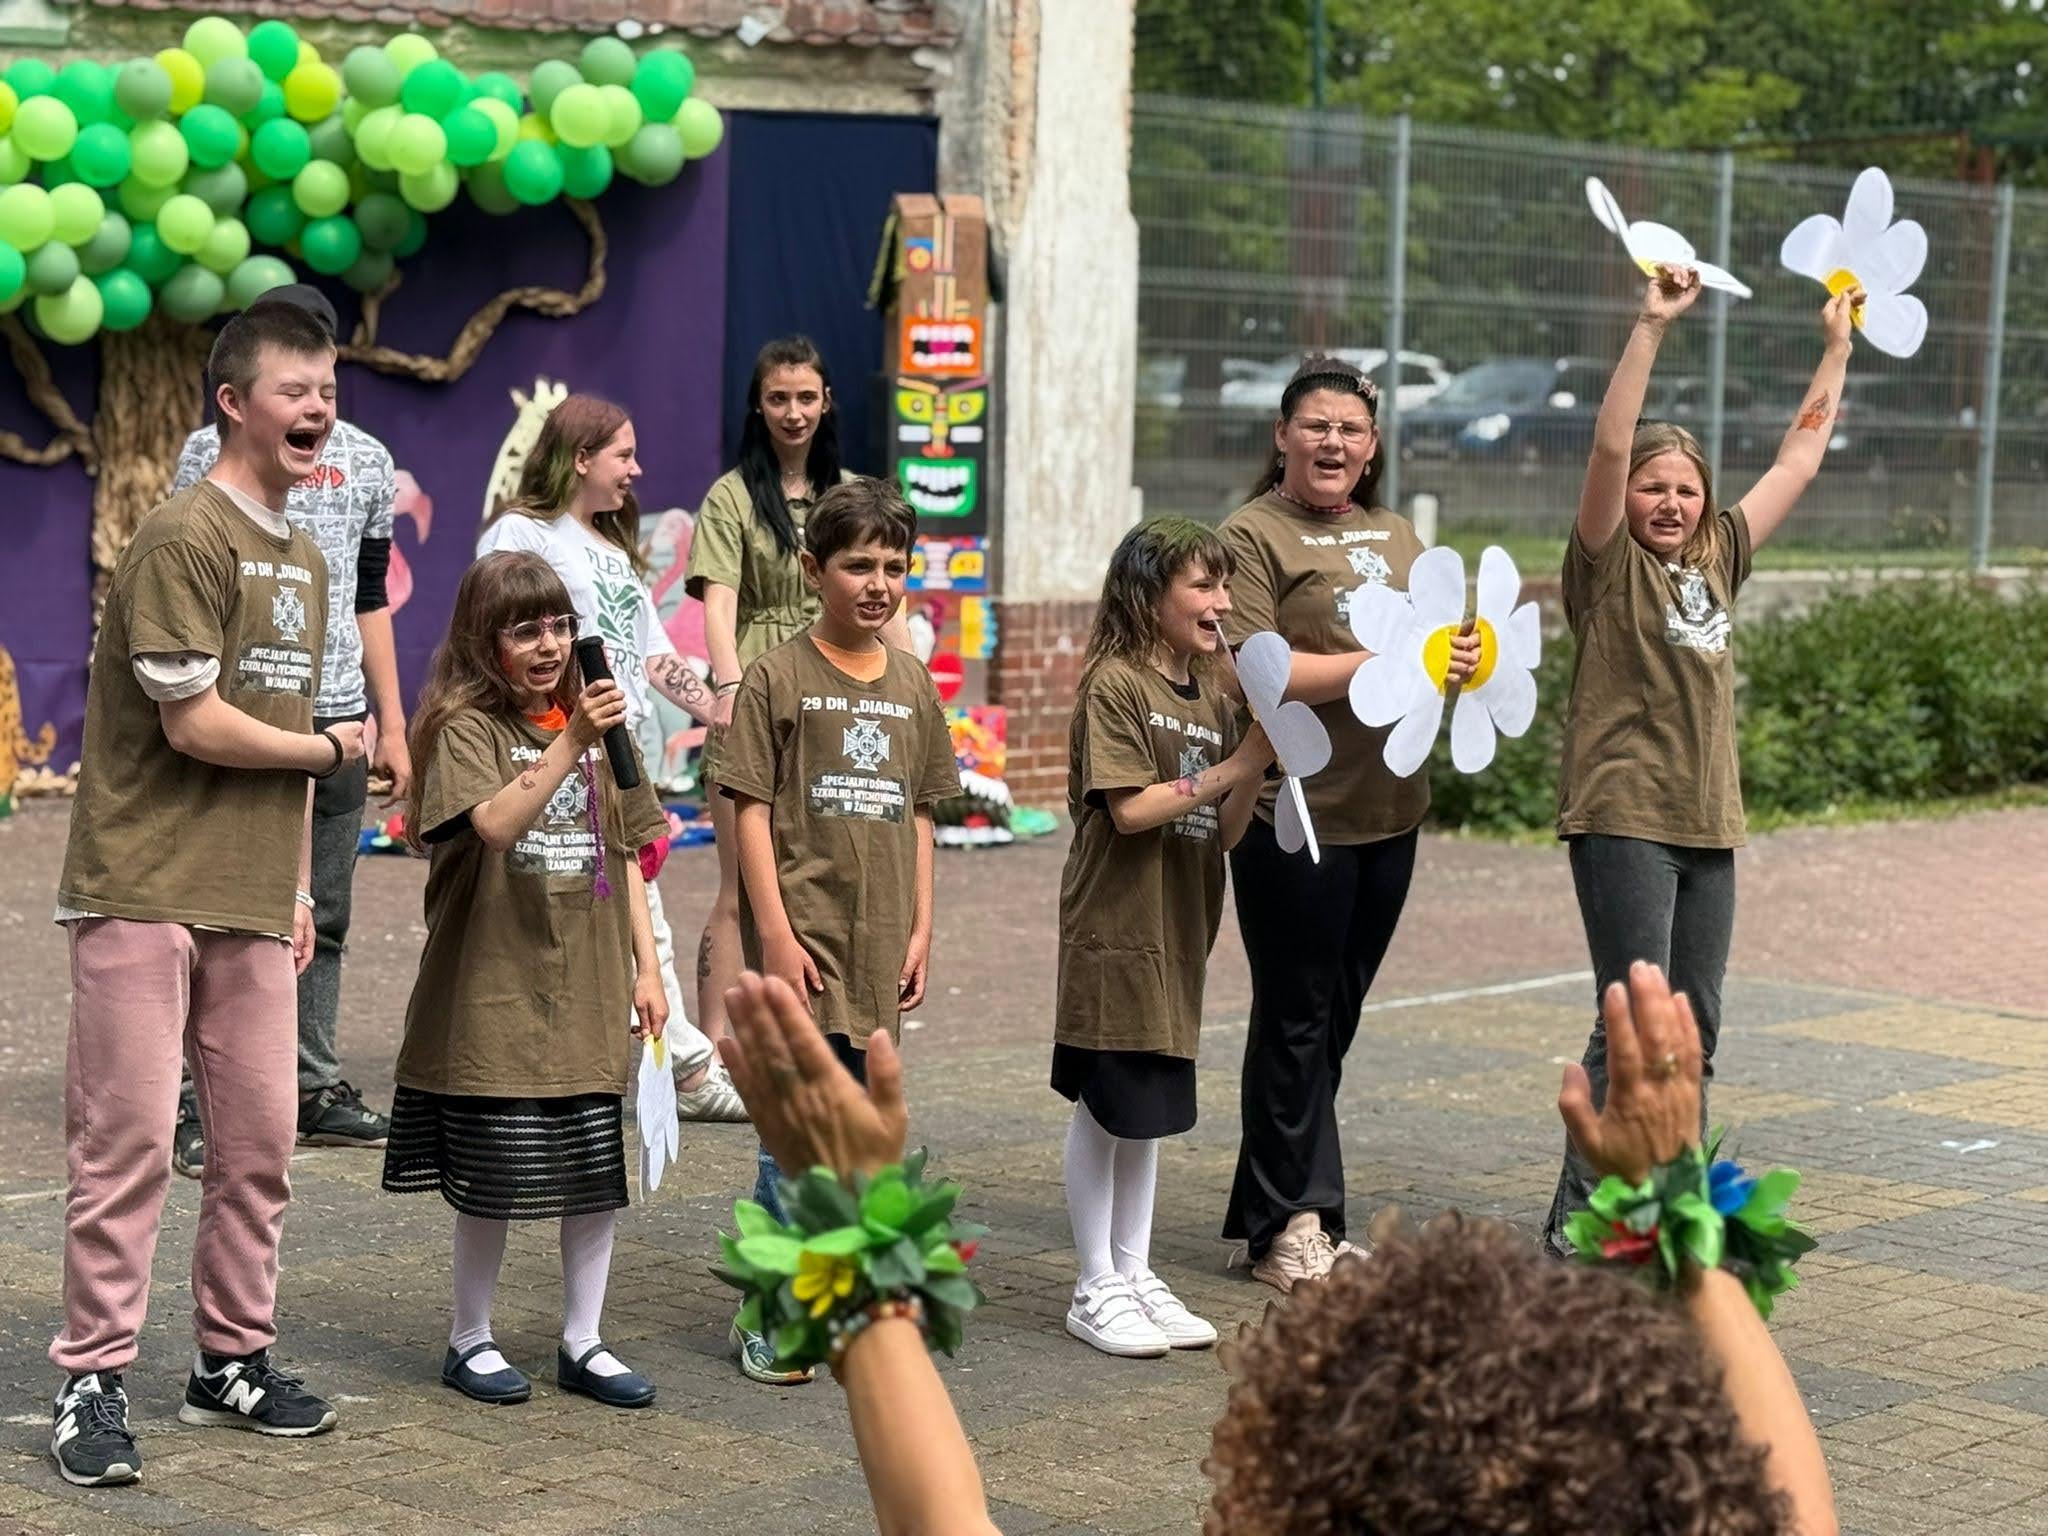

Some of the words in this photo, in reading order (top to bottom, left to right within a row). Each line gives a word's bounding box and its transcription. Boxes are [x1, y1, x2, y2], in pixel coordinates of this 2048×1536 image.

[241, 561, 257, 576] 29
[257, 561, 274, 577] DH
[802, 696, 822, 711] 29
[826, 696, 848, 711] DH
[1149, 711, 1165, 727] 29
[1165, 716, 1181, 732] DH
[844, 801, 853, 812] W
[223, 1378, 266, 1416] N
